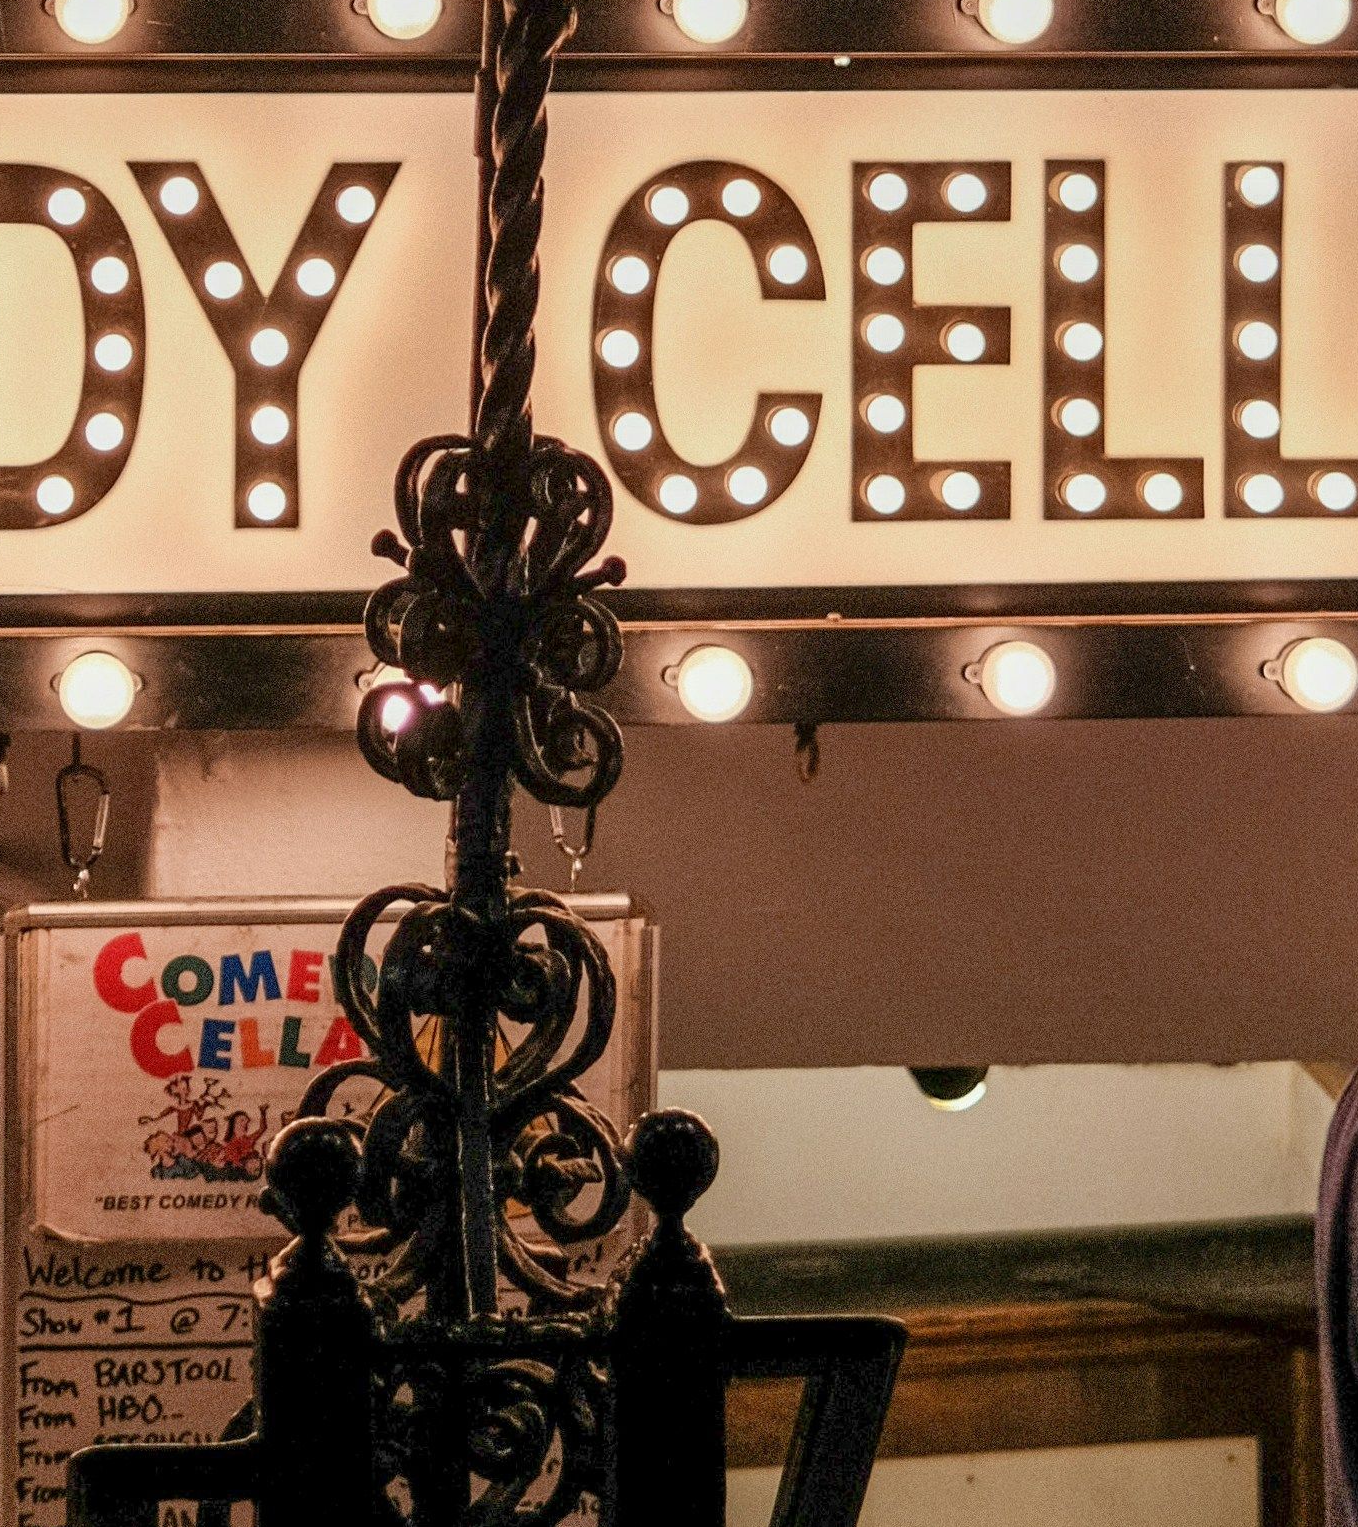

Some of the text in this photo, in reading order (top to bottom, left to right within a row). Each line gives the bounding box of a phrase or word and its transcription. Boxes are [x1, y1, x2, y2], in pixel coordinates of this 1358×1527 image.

[93, 932, 379, 1014] COMED
[130, 1000, 365, 1078] CELLA
[158, 1194, 241, 1210] COMEDY
[21, 1246, 170, 1289] Welcome
[190, 1254, 225, 1282] to
[19, 1307, 82, 1338] Show
[19, 1357, 238, 1397] From BARSTOOL
[18, 1404, 76, 1430] From
